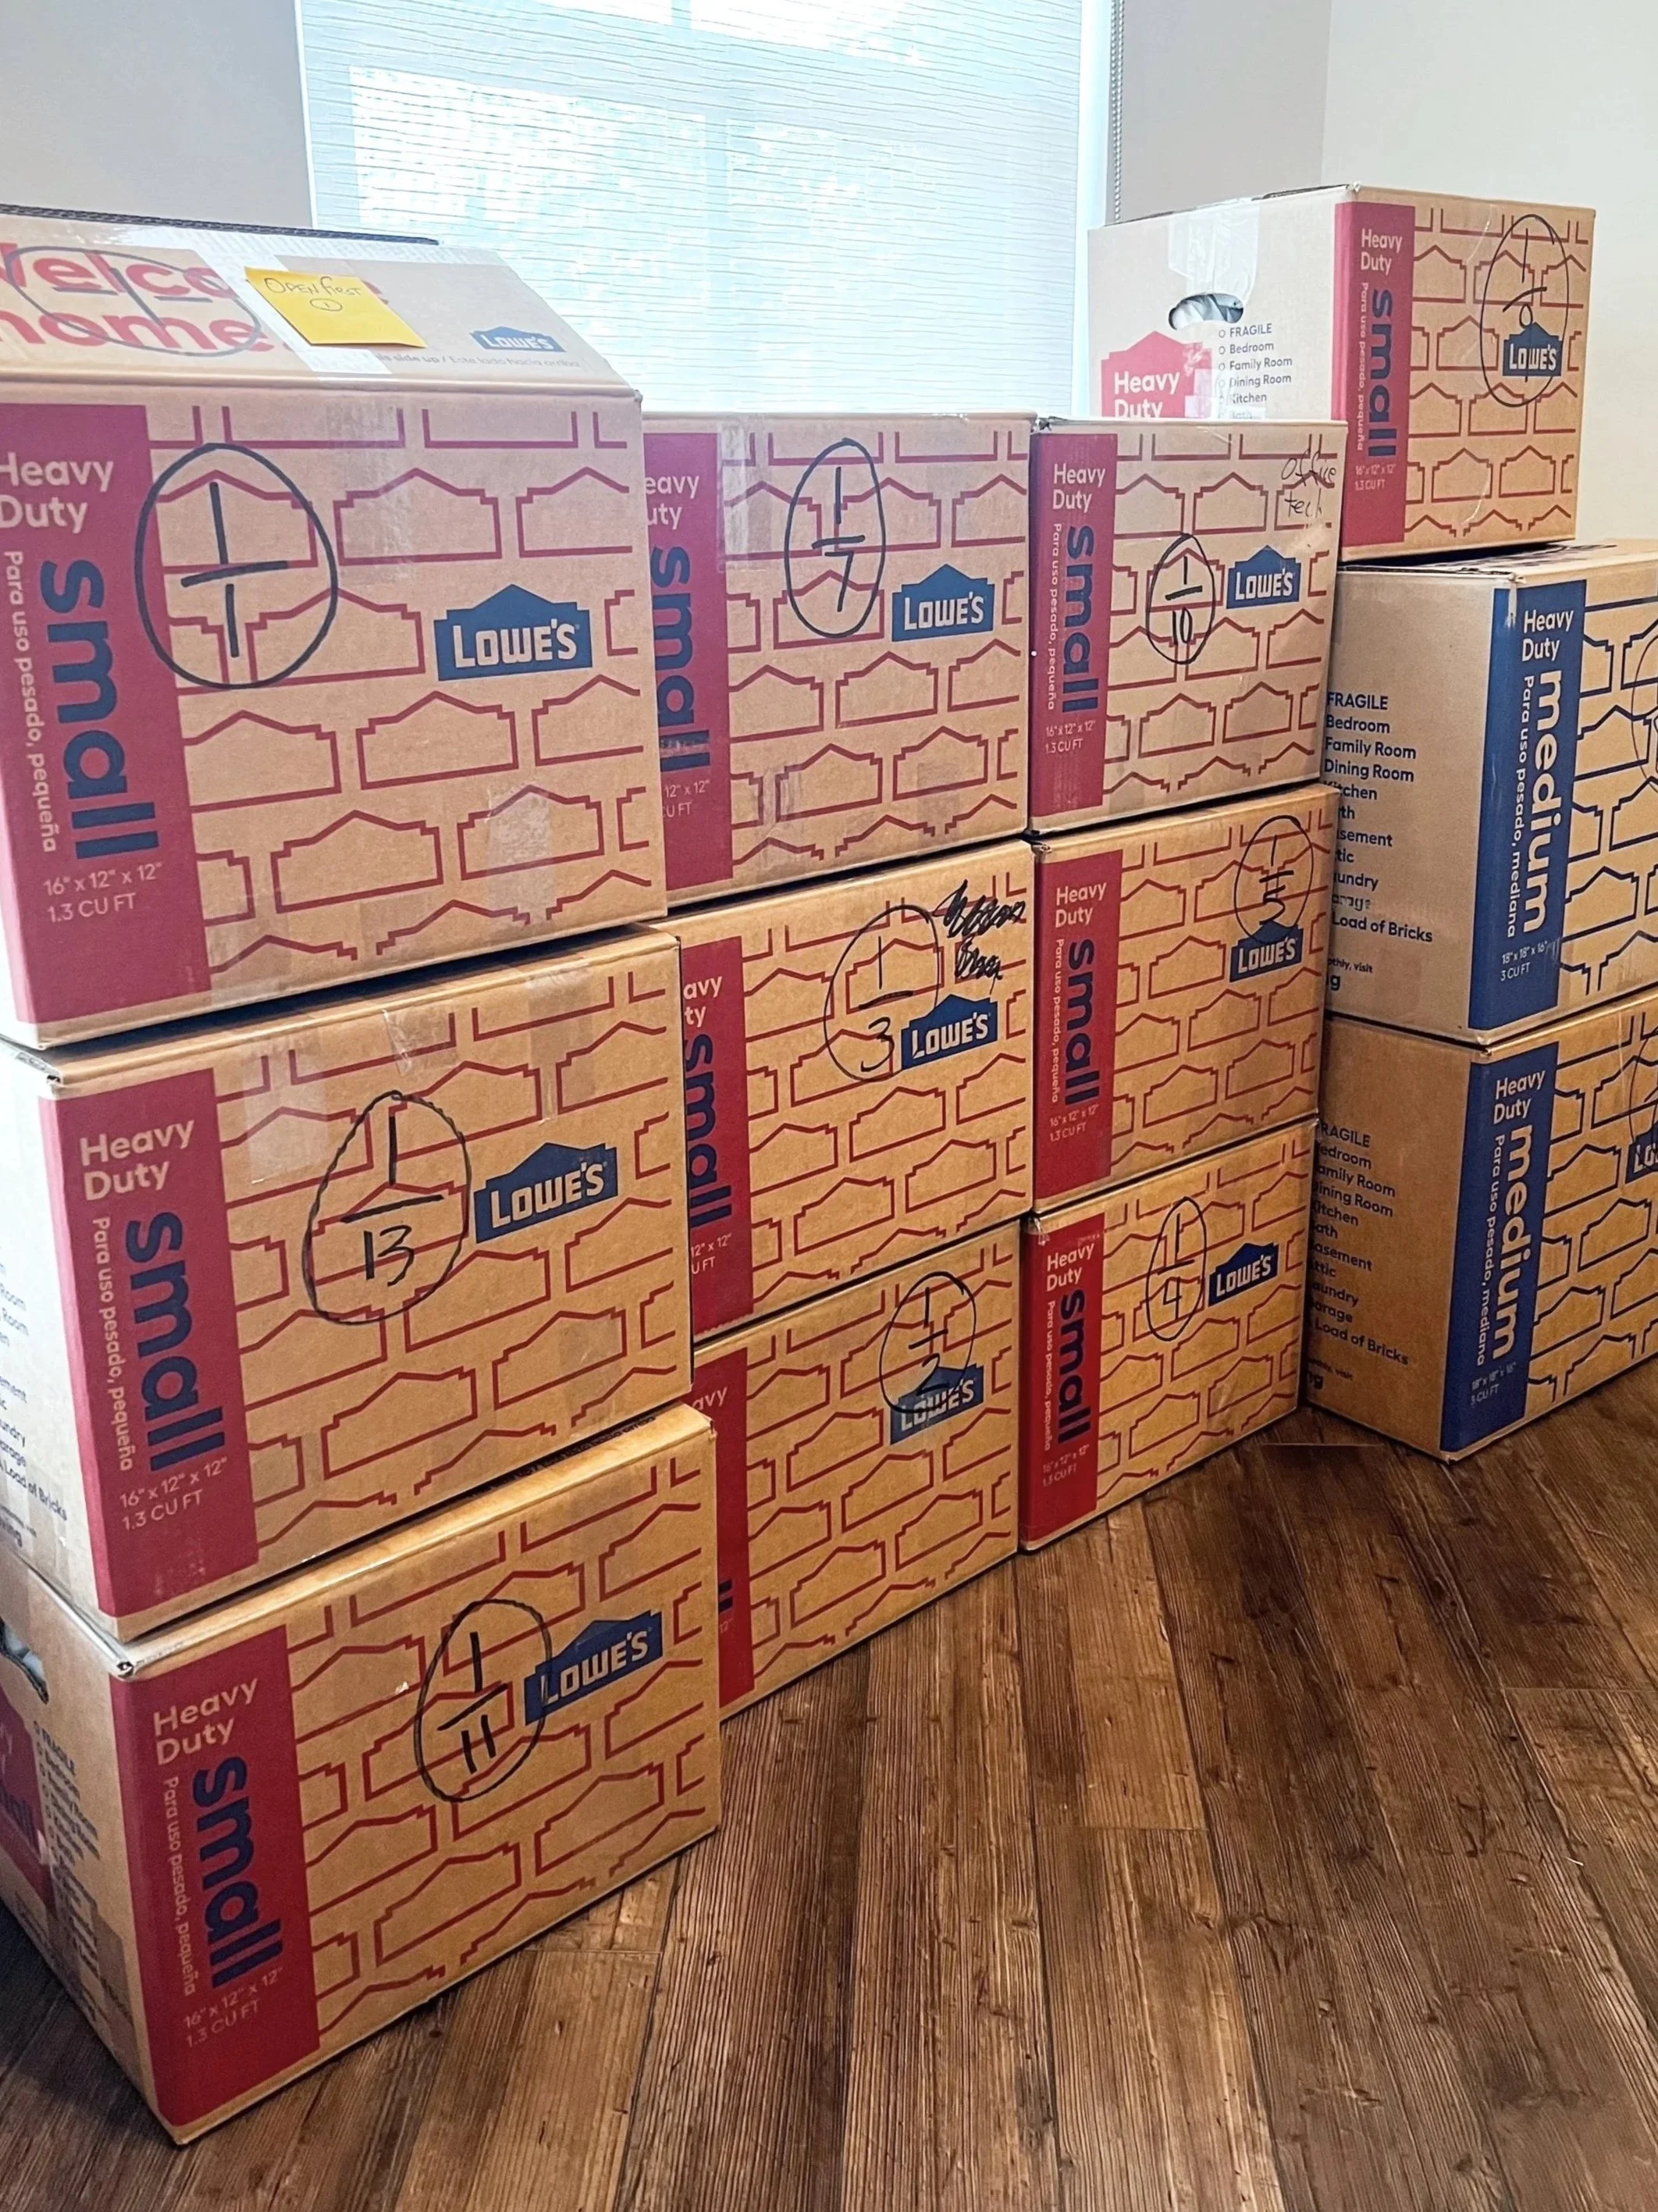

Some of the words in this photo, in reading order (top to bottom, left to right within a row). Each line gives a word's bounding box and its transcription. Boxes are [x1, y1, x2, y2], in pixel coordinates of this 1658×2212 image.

[1361, 228, 1403, 254] Heavy
[1361, 251, 1393, 276] Duty
[480, 334, 553, 351] LOWE'S
[1229, 322, 1272, 338] FRAGILE
[1229, 342, 1274, 354] Bedroom
[1229, 359, 1261, 372] Family
[1264, 357, 1293, 368] Room
[1368, 289, 1397, 457] small
[1509, 344, 1557, 370] LOWE'S
[1114, 371, 1179, 394] Heavy
[1264, 375, 1292, 386] Room
[645, 475, 700, 499] eavy
[1054, 463, 1105, 487] Heavy
[0, 494, 87, 534] Duty
[647, 503, 682, 530] uty
[1053, 490, 1093, 512] Duty
[210, 482, 227, 564] 1
[1053, 523, 1062, 556] Para
[4, 551, 23, 605] Para
[824, 550, 855, 612] 7
[1235, 568, 1293, 600] LOWE'S
[904, 592, 985, 632] LOWE'S
[1048, 588, 1058, 645] pesado,
[1062, 525, 1099, 713] small
[1172, 607, 1193, 645] 10
[1524, 610, 1574, 634] Heavy
[12, 611, 30, 652] uso
[453, 618, 578, 668] LOWE'S
[1522, 638, 1560, 661] Duty
[650, 545, 710, 772] small
[14, 657, 44, 747] pesado,
[40, 559, 159, 860] small
[1327, 692, 1389, 710] FRAGILE
[1521, 675, 1534, 723] Para
[1326, 714, 1390, 733] Bedroom
[1058, 740, 1071, 752] CU
[1073, 738, 1083, 750] FT
[1325, 736, 1372, 757] Family
[1375, 742, 1416, 759] Room
[1519, 728, 1528, 763] uso
[1324, 758, 1369, 780] Dining
[1373, 764, 1414, 782] Room
[26, 753, 59, 853] pequeña
[678, 802, 692, 816] FT
[684, 785, 690, 796] x
[1511, 768, 1526, 846] pesado,
[1523, 670, 1562, 932] medium
[1336, 829, 1393, 847] sement
[43, 876, 71, 896] 16"
[75, 879, 86, 892] x
[89, 869, 116, 889] 12"
[122, 871, 132, 884] x
[137, 862, 163, 882] 12"
[1055, 882, 1107, 907] Heavy
[1507, 851, 1521, 938] mediana
[48, 903, 74, 923] 1.3
[79, 898, 109, 917] CU
[115, 892, 137, 912] FT
[1055, 907, 1094, 928] Duty
[1332, 911, 1368, 930] Load
[1371, 920, 1386, 933] of
[1388, 922, 1433, 942] Bricks
[1055, 939, 1065, 970] Para
[1238, 938, 1297, 974] LOWE'S
[1507, 966, 1520, 979] CU
[1521, 962, 1530, 974] FT
[683, 976, 723, 999] avy
[911, 1013, 988, 1060] LOWE'S
[1064, 939, 1099, 1106] small
[860, 1017, 895, 1073] 3
[1496, 1070, 1546, 1099] Heavy
[1493, 1099, 1532, 1124] Duty
[80, 1119, 194, 1167] Heavy
[685, 1034, 732, 1229] small
[1493, 1134, 1505, 1177] Para
[84, 1161, 169, 1201] Duty
[490, 1162, 605, 1230] LOWE'S
[1357, 1174, 1396, 1197] Room
[1489, 1181, 1500, 1213] uso
[1354, 1194, 1393, 1217] Room
[92, 1216, 110, 1264] Para
[364, 1224, 414, 1287] 13
[708, 1242, 713, 1251] x
[1047, 1243, 1094, 1272] Heavy
[1315, 1243, 1373, 1271] asement
[1482, 1216, 1496, 1285] pesado,
[1493, 1124, 1532, 1360] medium
[98, 1269, 115, 1303] uso
[1047, 1267, 1082, 1291] Duty
[1215, 1255, 1272, 1298] LOWE'S
[1163, 1277, 1182, 1320] 4
[100, 1306, 126, 1384] pesado,
[126, 1212, 226, 1472] small
[1315, 1318, 1348, 1341] Load
[1351, 1335, 1365, 1348] of
[1368, 1339, 1409, 1366] Bricks
[1477, 1289, 1490, 1366] mediana
[1057, 1289, 1091, 1444] small
[107, 1387, 136, 1471] pequeña
[119, 1488, 144, 1509] 16"
[148, 1488, 158, 1501] x
[161, 1473, 185, 1494] 12"
[190, 1473, 200, 1485] x
[205, 1457, 227, 1477] 12"
[123, 1512, 147, 1531] 1.3
[151, 1502, 179, 1522] CU
[183, 1489, 204, 1510] FT
[540, 1630, 649, 1706] LOWE'S
[154, 1678, 258, 1736] Heavy
[157, 1718, 234, 1766] Duty
[164, 1776, 180, 1819] Para
[167, 1821, 181, 1850] uso
[168, 1853, 191, 1921] pesado,
[193, 1756, 283, 1989] small
[176, 1922, 199, 1996] pequeña
[209, 2005, 219, 2017] x
[250, 1982, 258, 1994] x
[212, 2011, 236, 2034] CU
[240, 1999, 260, 2019] FT
